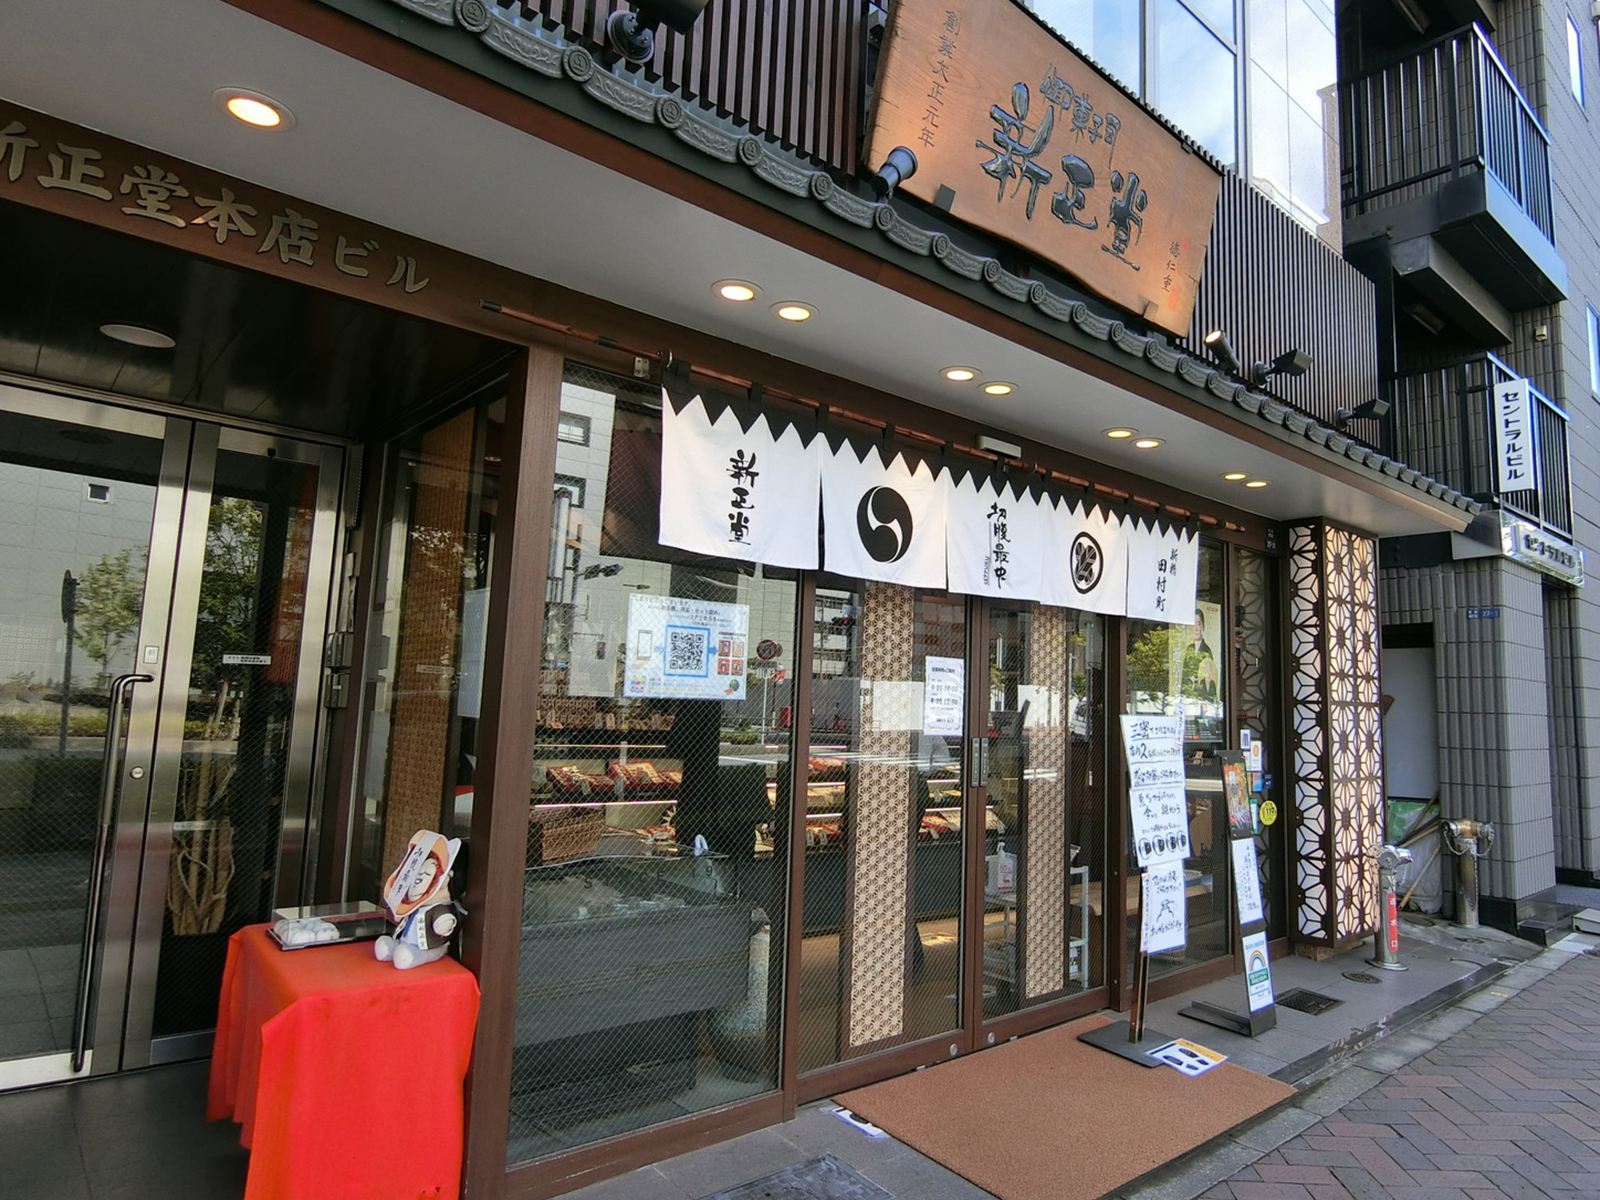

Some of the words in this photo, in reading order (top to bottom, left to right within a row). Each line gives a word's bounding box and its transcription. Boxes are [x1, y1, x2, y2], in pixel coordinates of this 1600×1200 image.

[918, 10, 962, 148] 創業大正元年
[976, 82, 1149, 272] 新正堂
[1501, 391, 1525, 481] セントラルビル
[726, 449, 760, 546] 新正堂
[1155, 558, 1168, 612] 田村町
